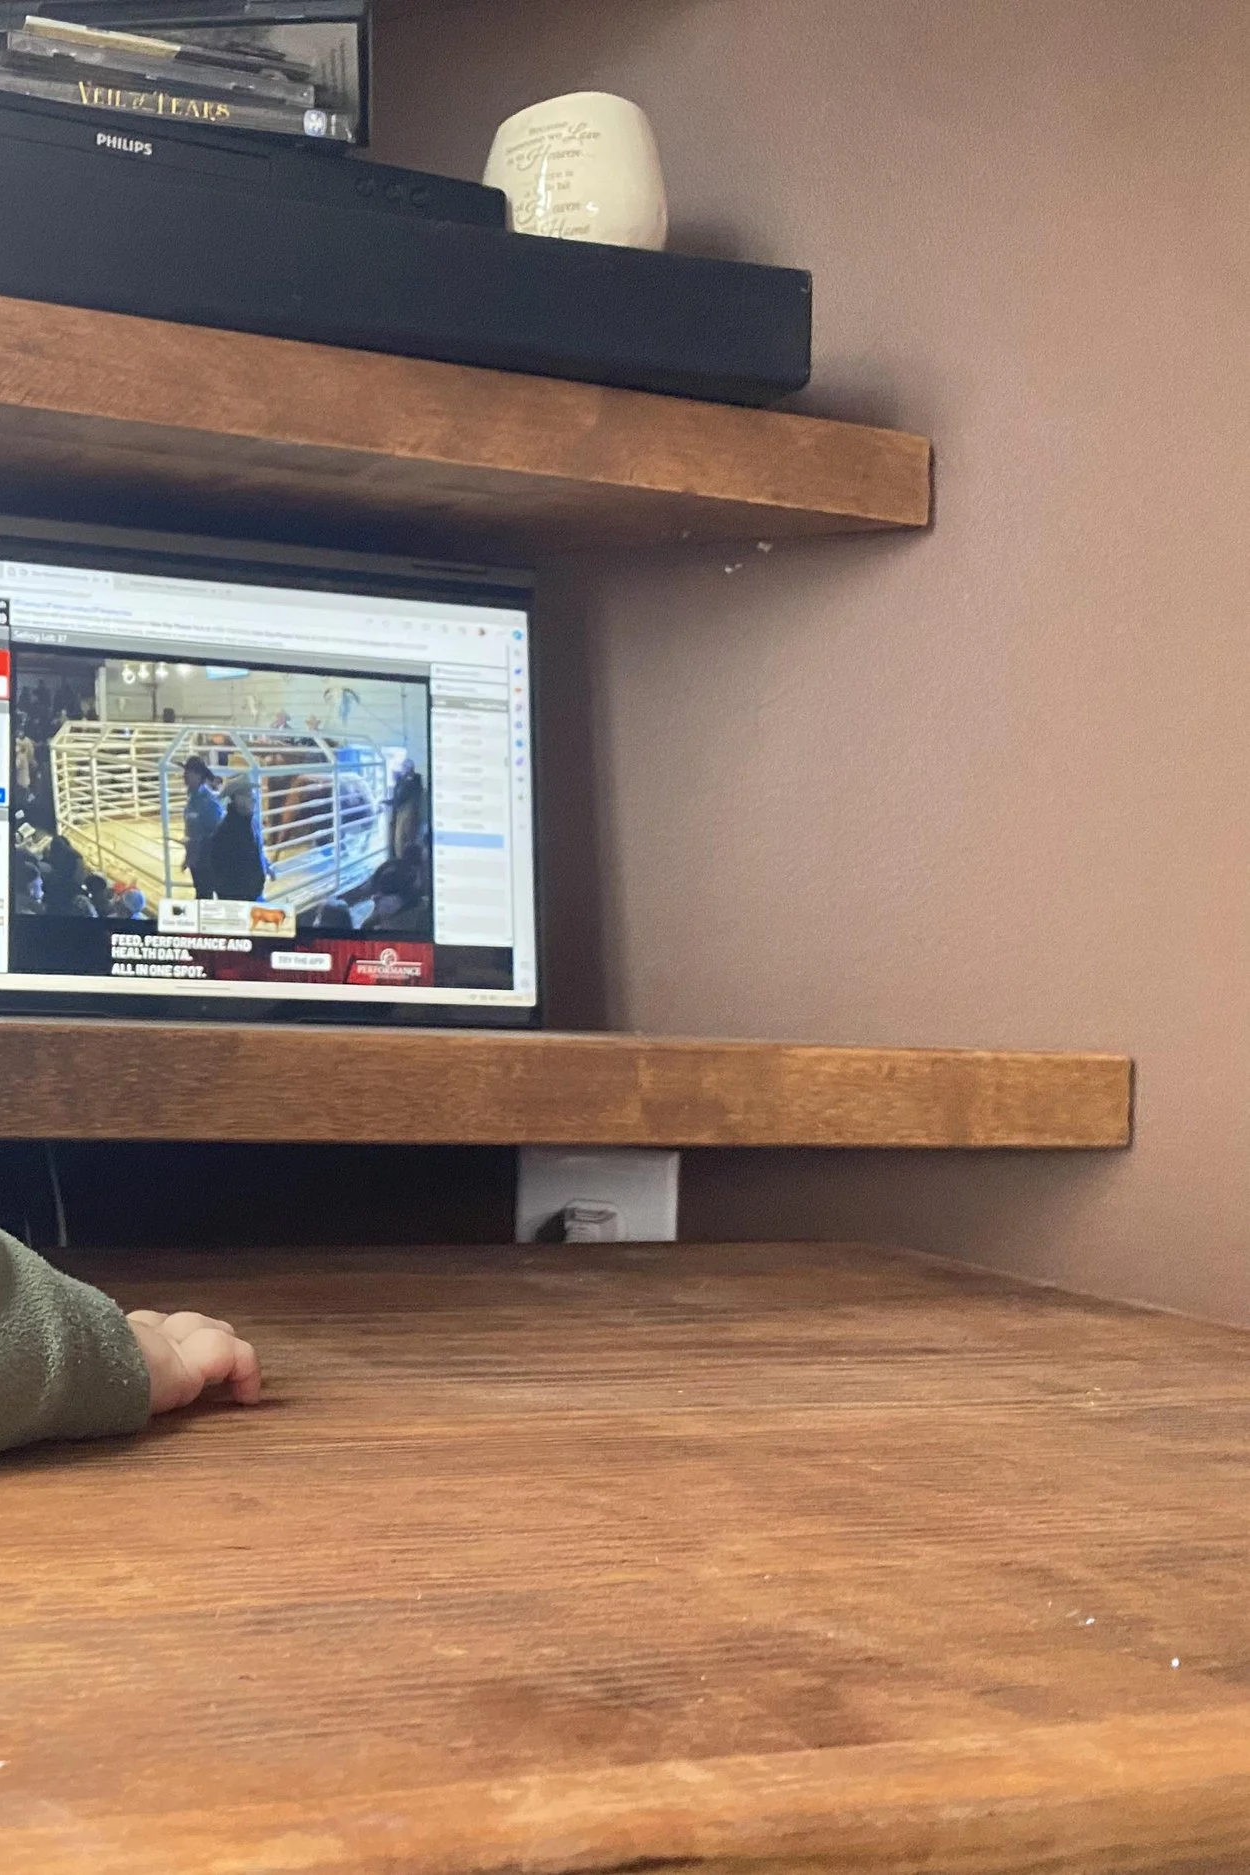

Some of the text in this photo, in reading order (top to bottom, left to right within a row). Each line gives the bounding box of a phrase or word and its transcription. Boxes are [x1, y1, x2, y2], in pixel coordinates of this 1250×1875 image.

[96, 132, 153, 156] PHILIPS
[111, 934, 253, 952] FEED, PERFORMANCE AND
[111, 947, 194, 961] HEALTH DATA.
[111, 962, 207, 978] ALL IN ONE SPOT.
[357, 964, 422, 977] PERFORMANCE
